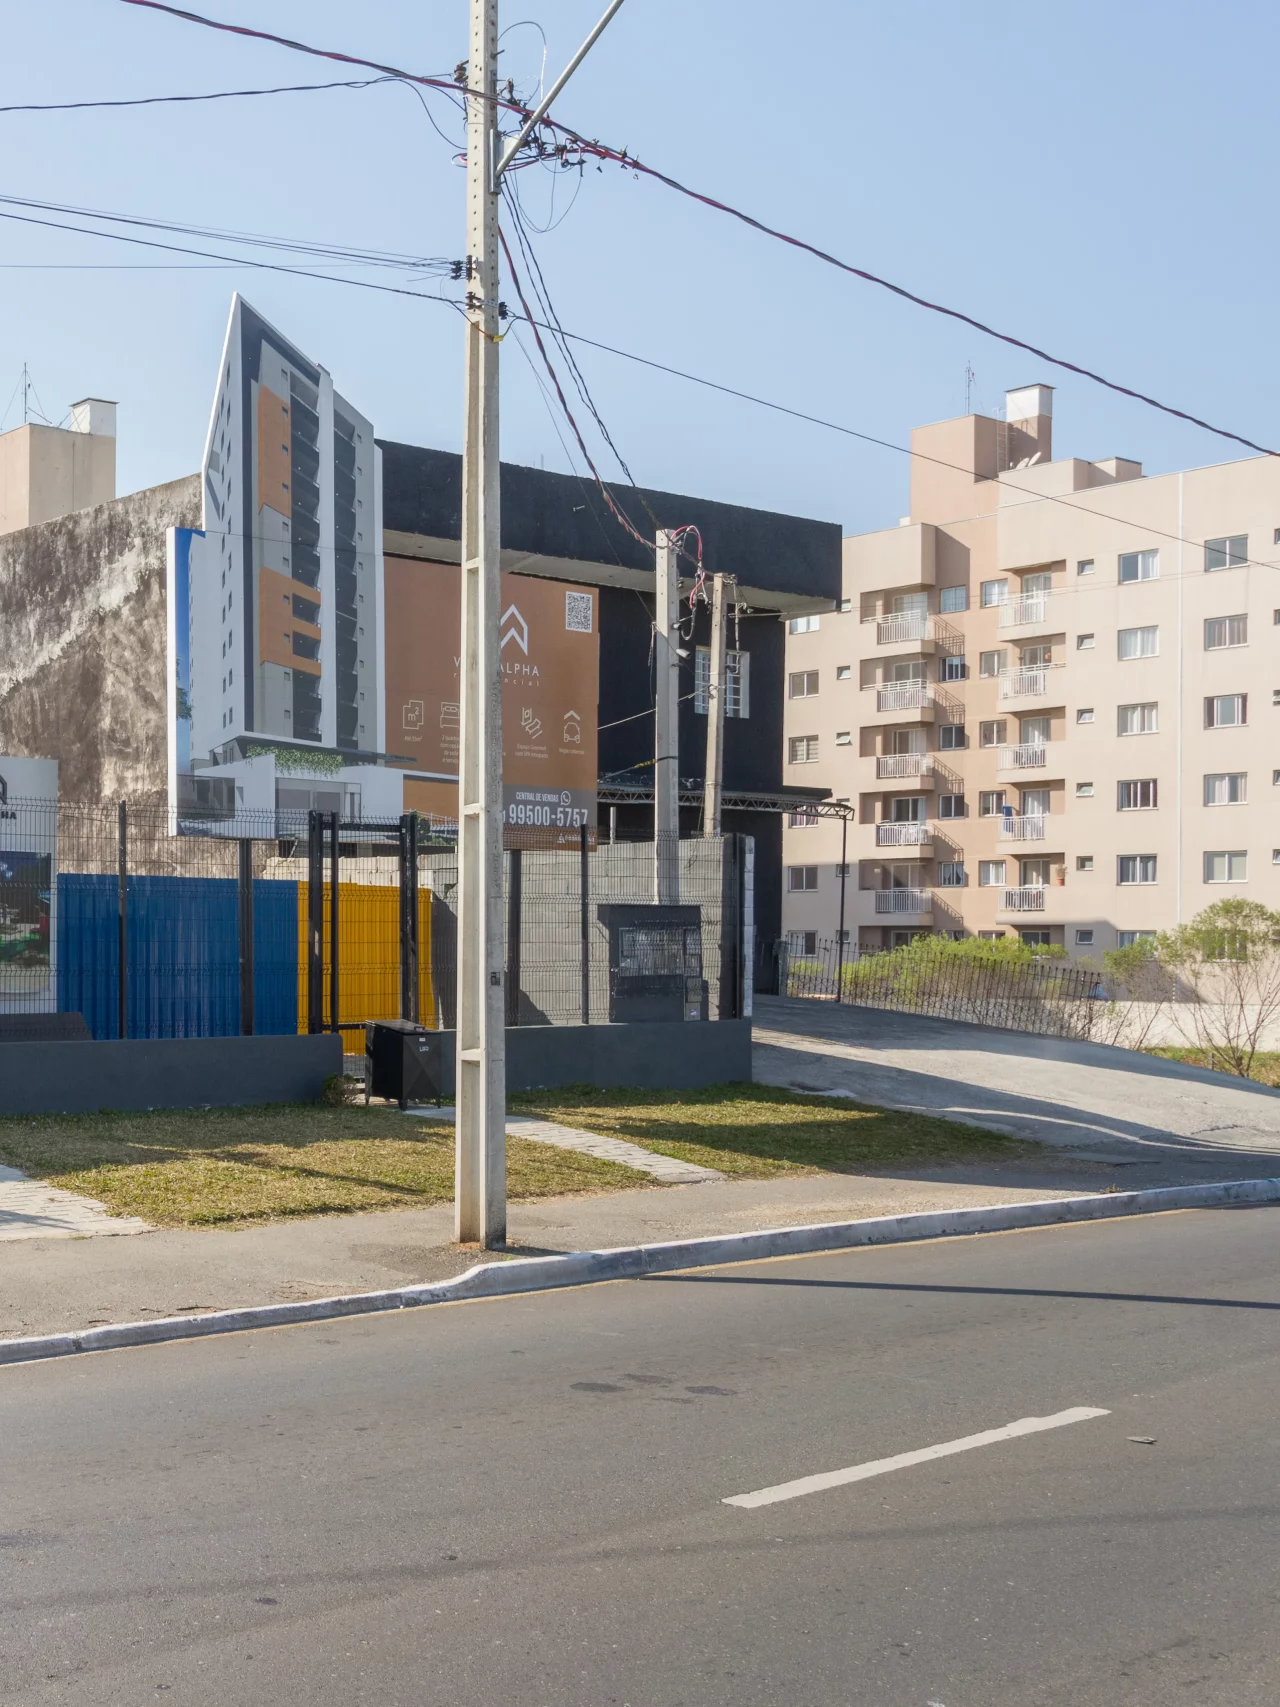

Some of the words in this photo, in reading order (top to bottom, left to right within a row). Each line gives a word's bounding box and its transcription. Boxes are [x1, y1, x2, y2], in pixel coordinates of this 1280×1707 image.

[515, 791, 535, 801] CENTRAL
[535, 792, 542, 801] DE
[542, 793, 560, 803] VENDAS
[509, 803, 589, 828] 99500-5757
